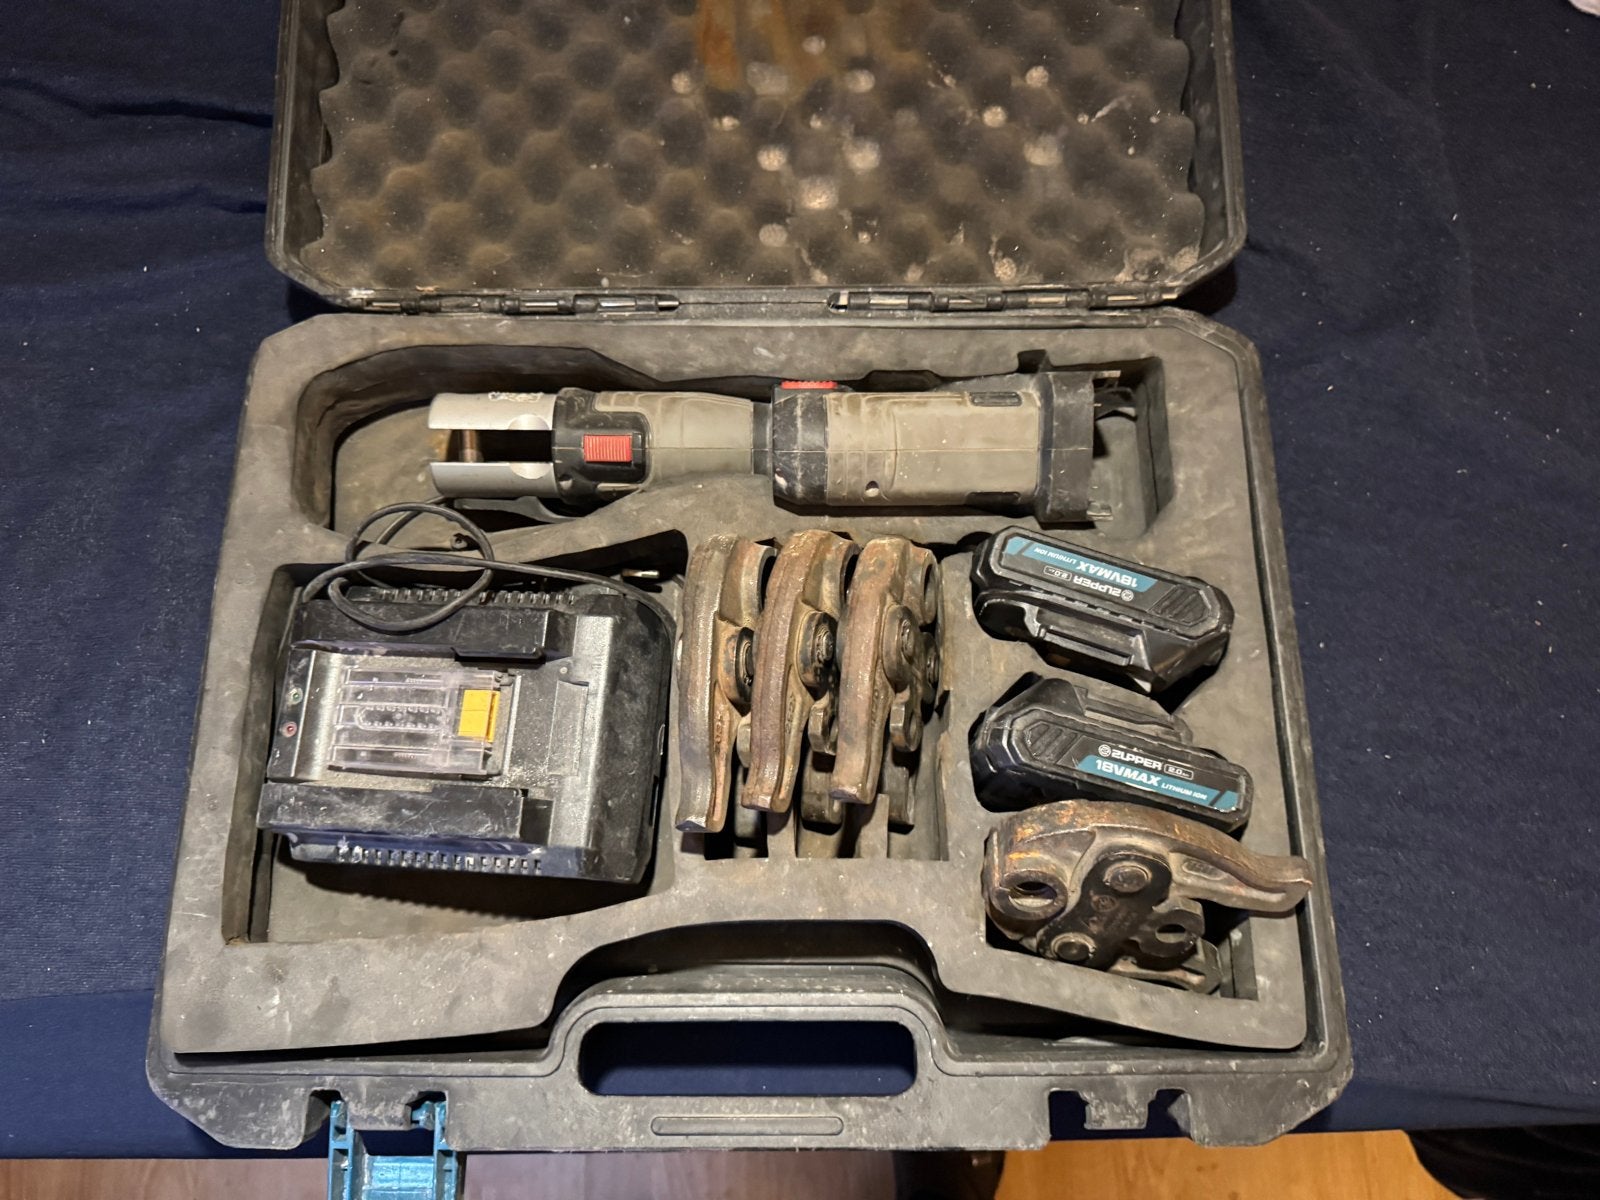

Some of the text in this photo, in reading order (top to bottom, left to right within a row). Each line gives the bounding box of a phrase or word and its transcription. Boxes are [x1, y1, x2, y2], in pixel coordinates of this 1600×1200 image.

[1034, 547, 1138, 588] 18VMAX LITHIUM ION
[1073, 575, 1122, 598] ZUPPER
[1111, 749, 1163, 772] ZUPPER
[1095, 759, 1208, 801] 18VMAX LITHIUM ION
